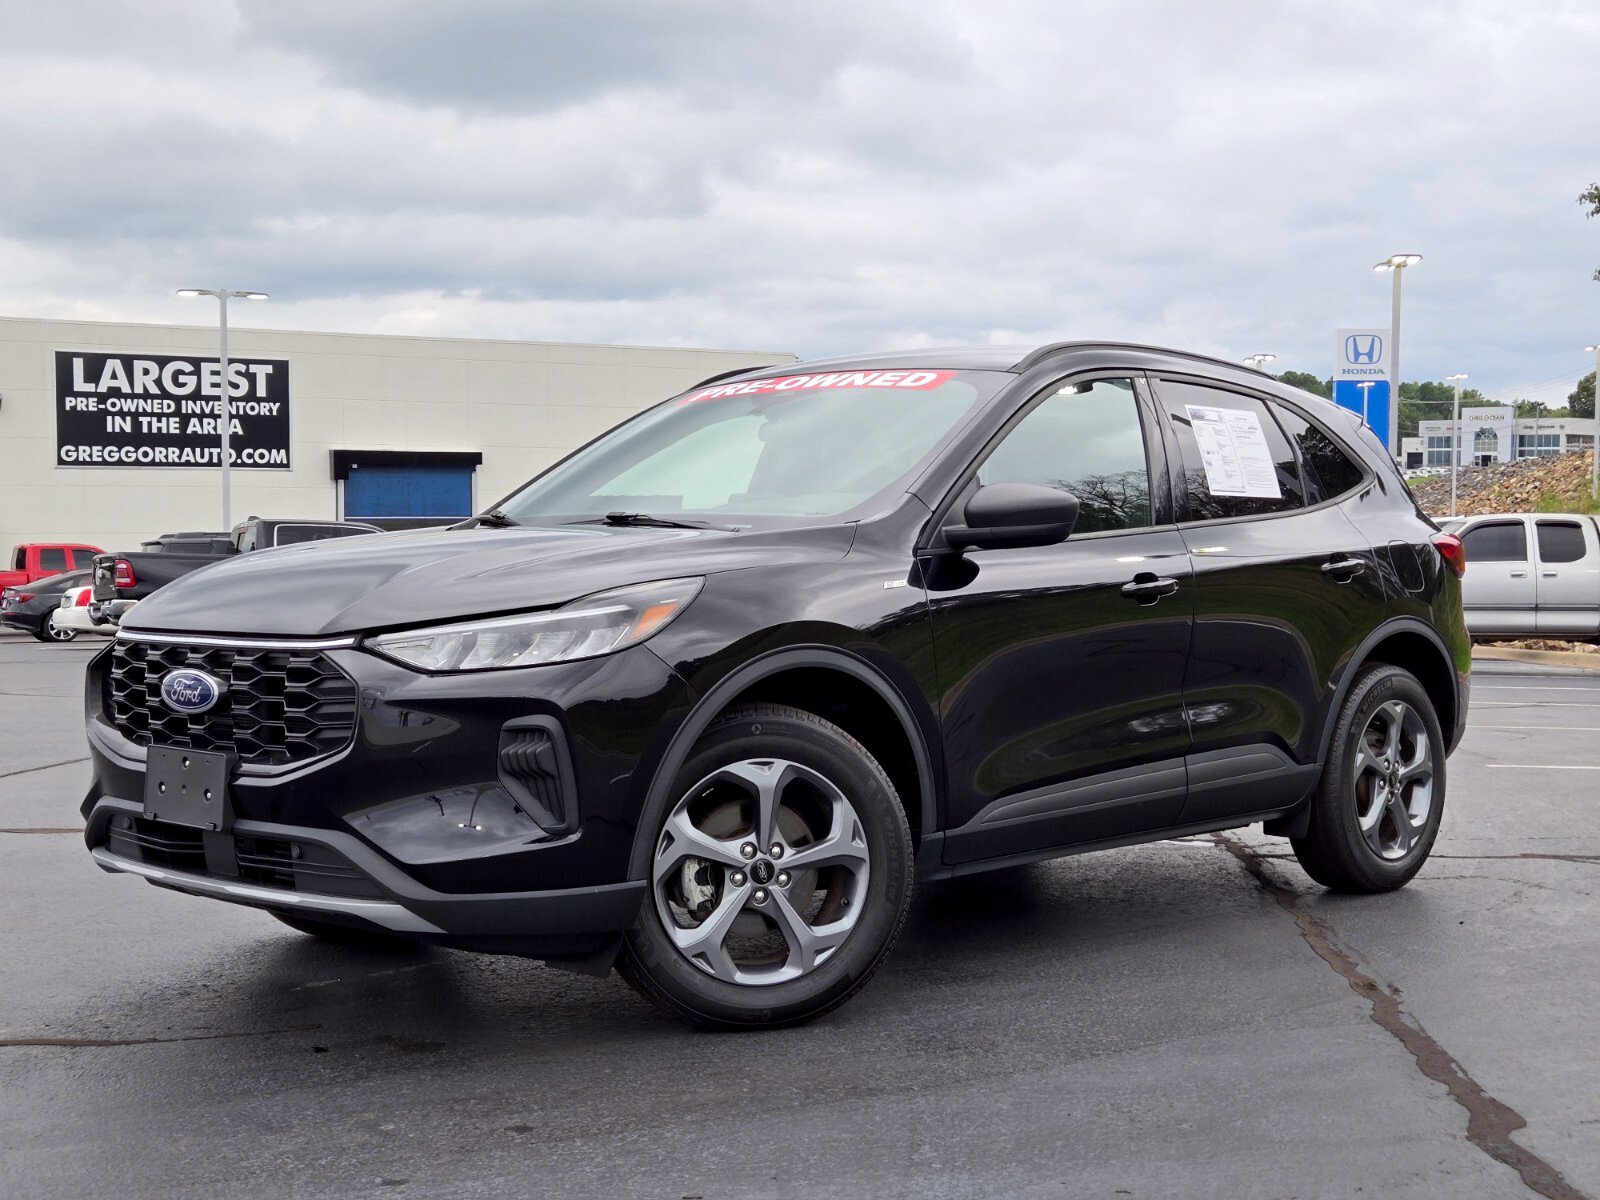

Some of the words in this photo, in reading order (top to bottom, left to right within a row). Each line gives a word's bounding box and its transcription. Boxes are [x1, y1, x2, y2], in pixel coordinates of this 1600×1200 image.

[72, 357, 274, 398] LARGEST
[688, 371, 938, 402] PRE-OWNED
[65, 397, 176, 413] PRE-OWNED
[181, 400, 281, 416] INVENTORY
[106, 415, 132, 433] IN
[138, 416, 181, 434] THE
[60, 445, 287, 464] GREGGORRAUTO.COM
[170, 678, 201, 702] Ford
